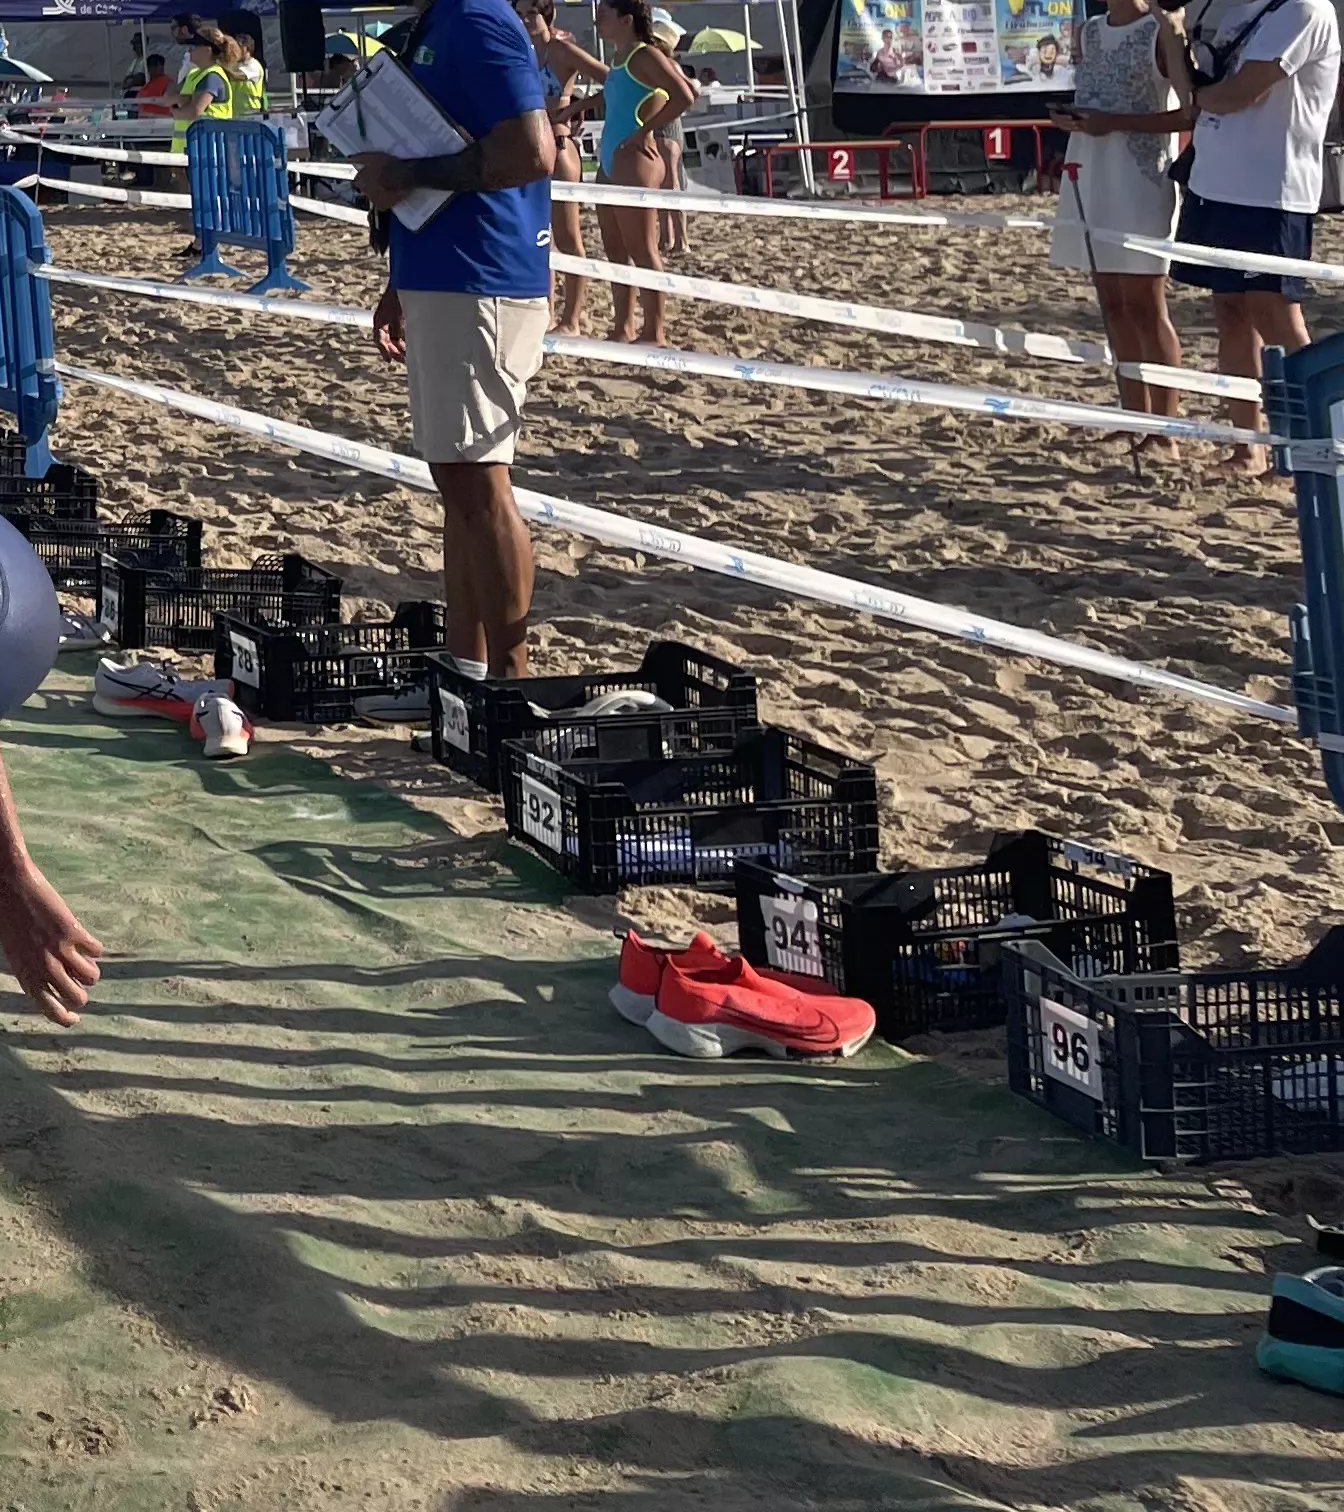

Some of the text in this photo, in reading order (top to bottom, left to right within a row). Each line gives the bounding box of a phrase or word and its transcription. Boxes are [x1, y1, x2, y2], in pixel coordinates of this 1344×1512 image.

[80, 4, 92, 15] de
[989, 127, 1003, 154] 1
[832, 149, 850, 175] 2
[528, 793, 555, 833] 92
[772, 915, 810, 955] 94
[1051, 1022, 1090, 1073] 96
